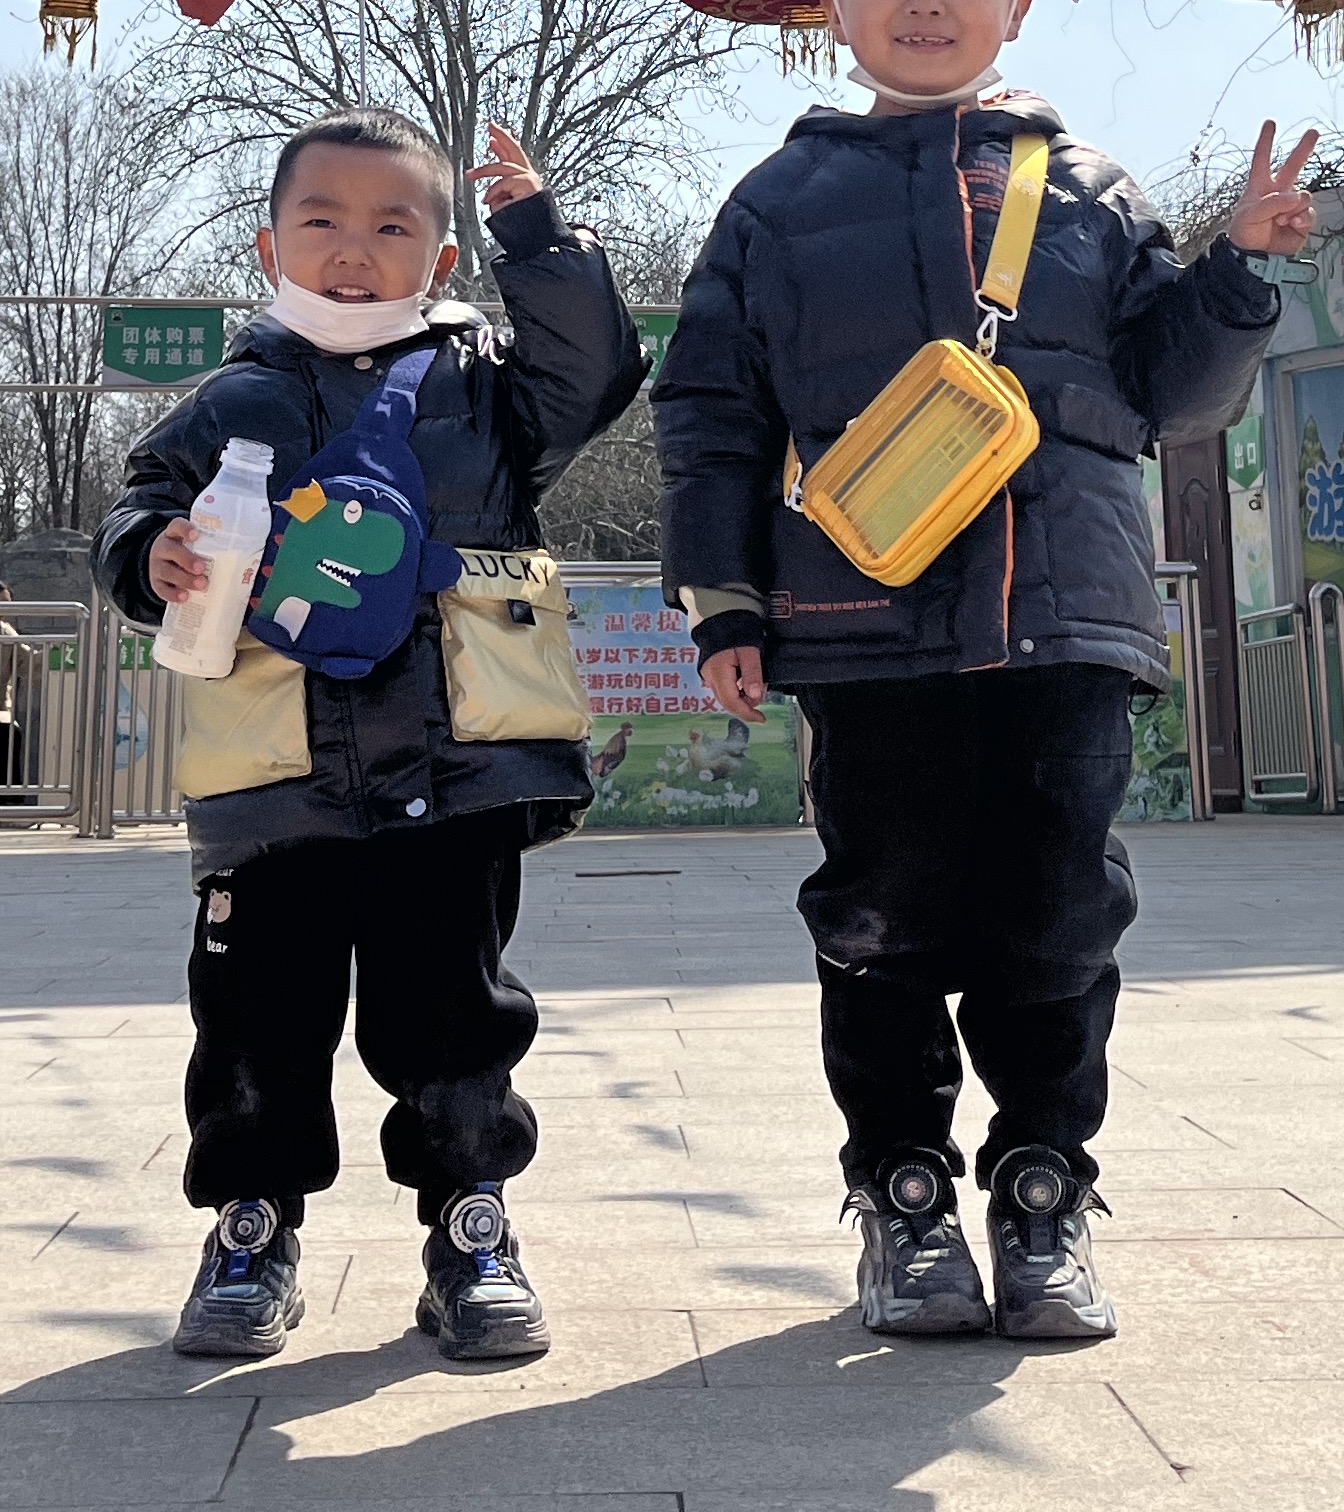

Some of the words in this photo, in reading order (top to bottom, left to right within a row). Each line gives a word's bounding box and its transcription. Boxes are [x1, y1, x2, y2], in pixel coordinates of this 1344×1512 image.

[122, 327, 205, 344] 团体购票
[121, 347, 205, 365] 专用通道
[1234, 443, 1256, 470] 出口
[461, 554, 550, 587] LUCKY
[604, 610, 682, 634] 温馨提
[578, 672, 711, 691] 游玩的同时，
[207, 935, 228, 954] bear
